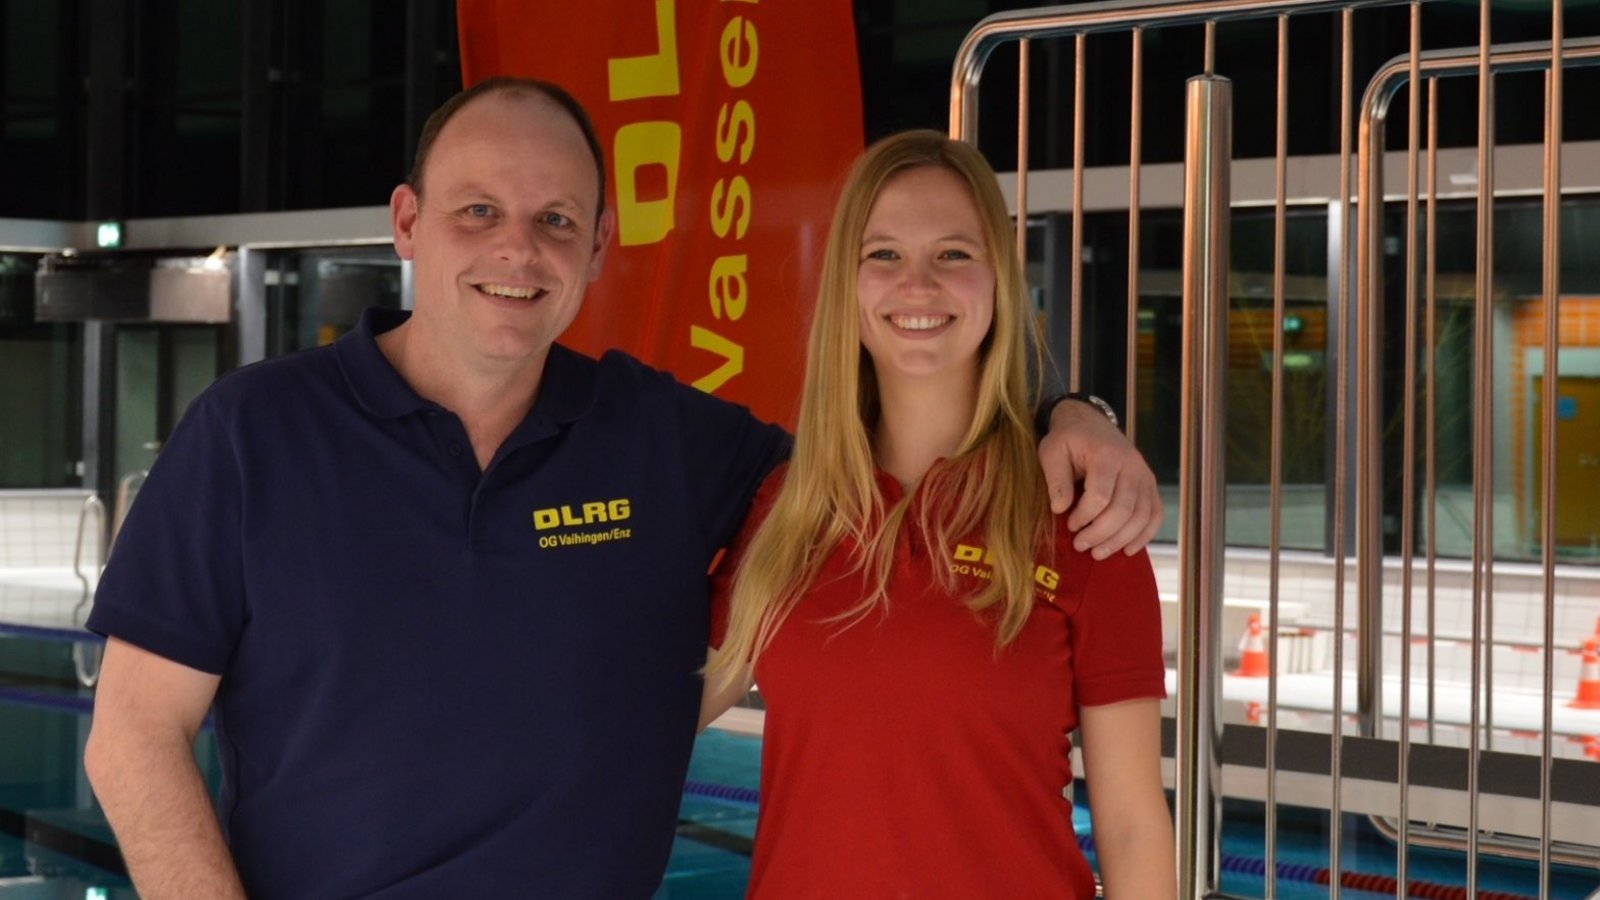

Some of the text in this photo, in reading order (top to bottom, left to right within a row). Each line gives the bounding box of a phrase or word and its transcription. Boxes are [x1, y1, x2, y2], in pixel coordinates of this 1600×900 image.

[690, 0, 759, 394] asse
[533, 499, 631, 530] DLRG
[539, 528, 631, 548] OG Vaihingen/Enz
[953, 544, 1060, 590] DG
